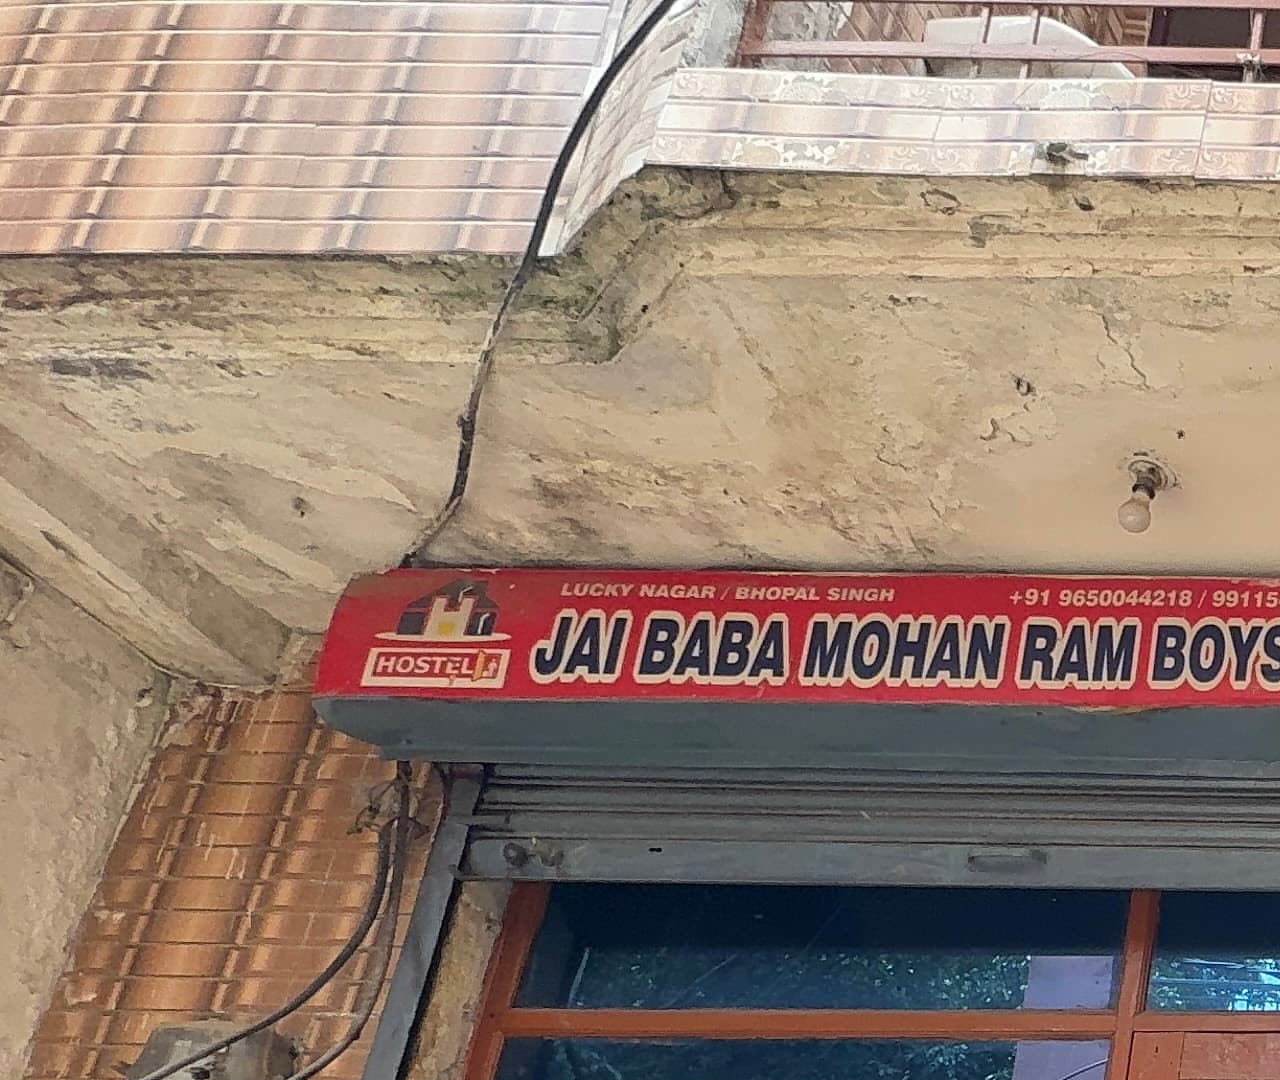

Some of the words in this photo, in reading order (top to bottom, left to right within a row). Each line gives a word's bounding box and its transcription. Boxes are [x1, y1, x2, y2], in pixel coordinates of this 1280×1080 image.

[561, 583, 634, 599] LUCKY
[640, 585, 716, 600] NAGAR
[735, 585, 821, 601] BHOPAL
[827, 586, 895, 602] SINGH
[1010, 589, 1050, 606] +91
[1058, 590, 1193, 608] 9650044218
[532, 613, 630, 680] JAI
[636, 615, 787, 681] BABA
[802, 615, 1008, 685] MOHAN
[1019, 620, 1140, 686] RAM
[376, 655, 474, 675] HOSTEL
